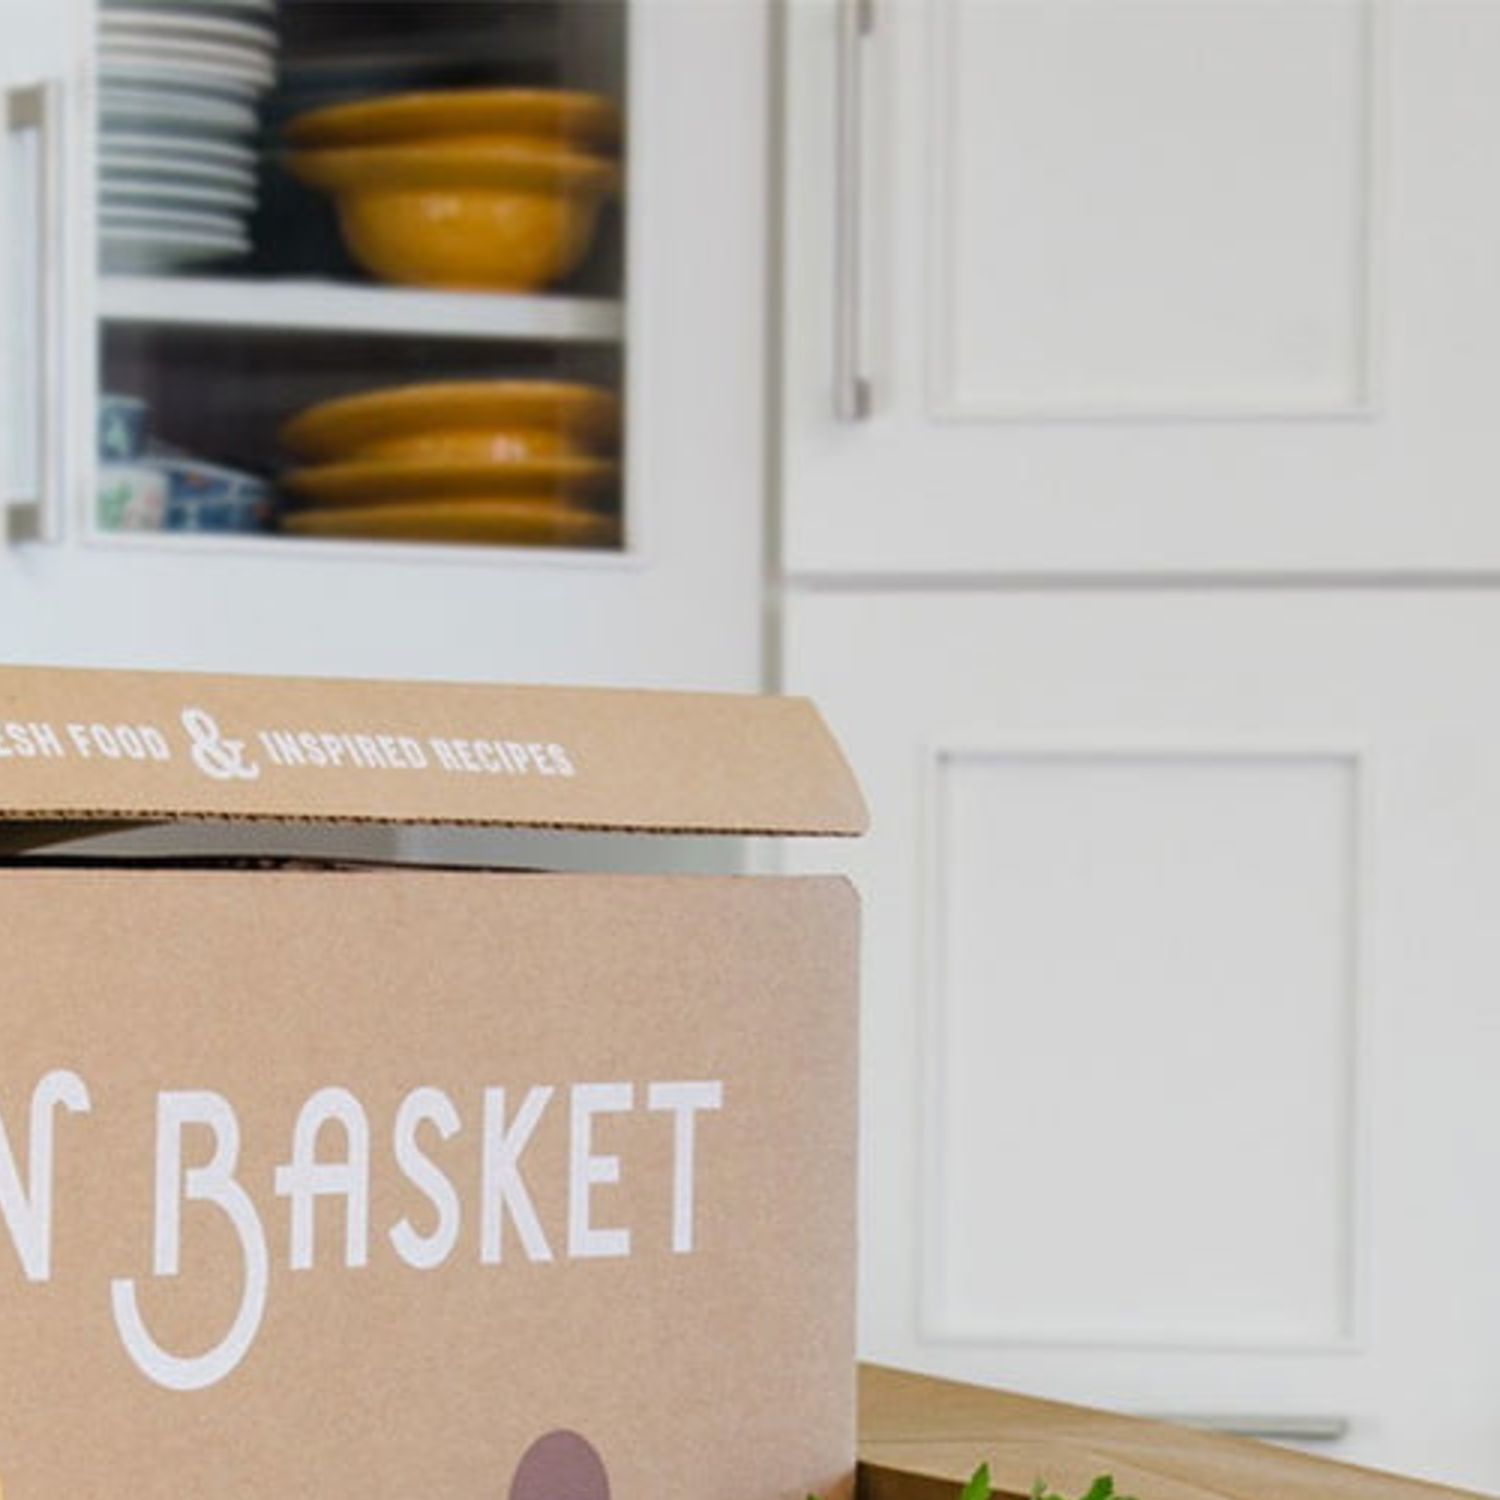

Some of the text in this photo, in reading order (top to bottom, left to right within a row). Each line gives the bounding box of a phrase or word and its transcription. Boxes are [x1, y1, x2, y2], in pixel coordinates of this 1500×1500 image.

[67, 722, 172, 762] FOOD
[180, 706, 259, 780] &
[258, 731, 428, 769] INSPIRED
[430, 736, 576, 776] RECIPES
[110, 1079, 724, 1390] BASKET
